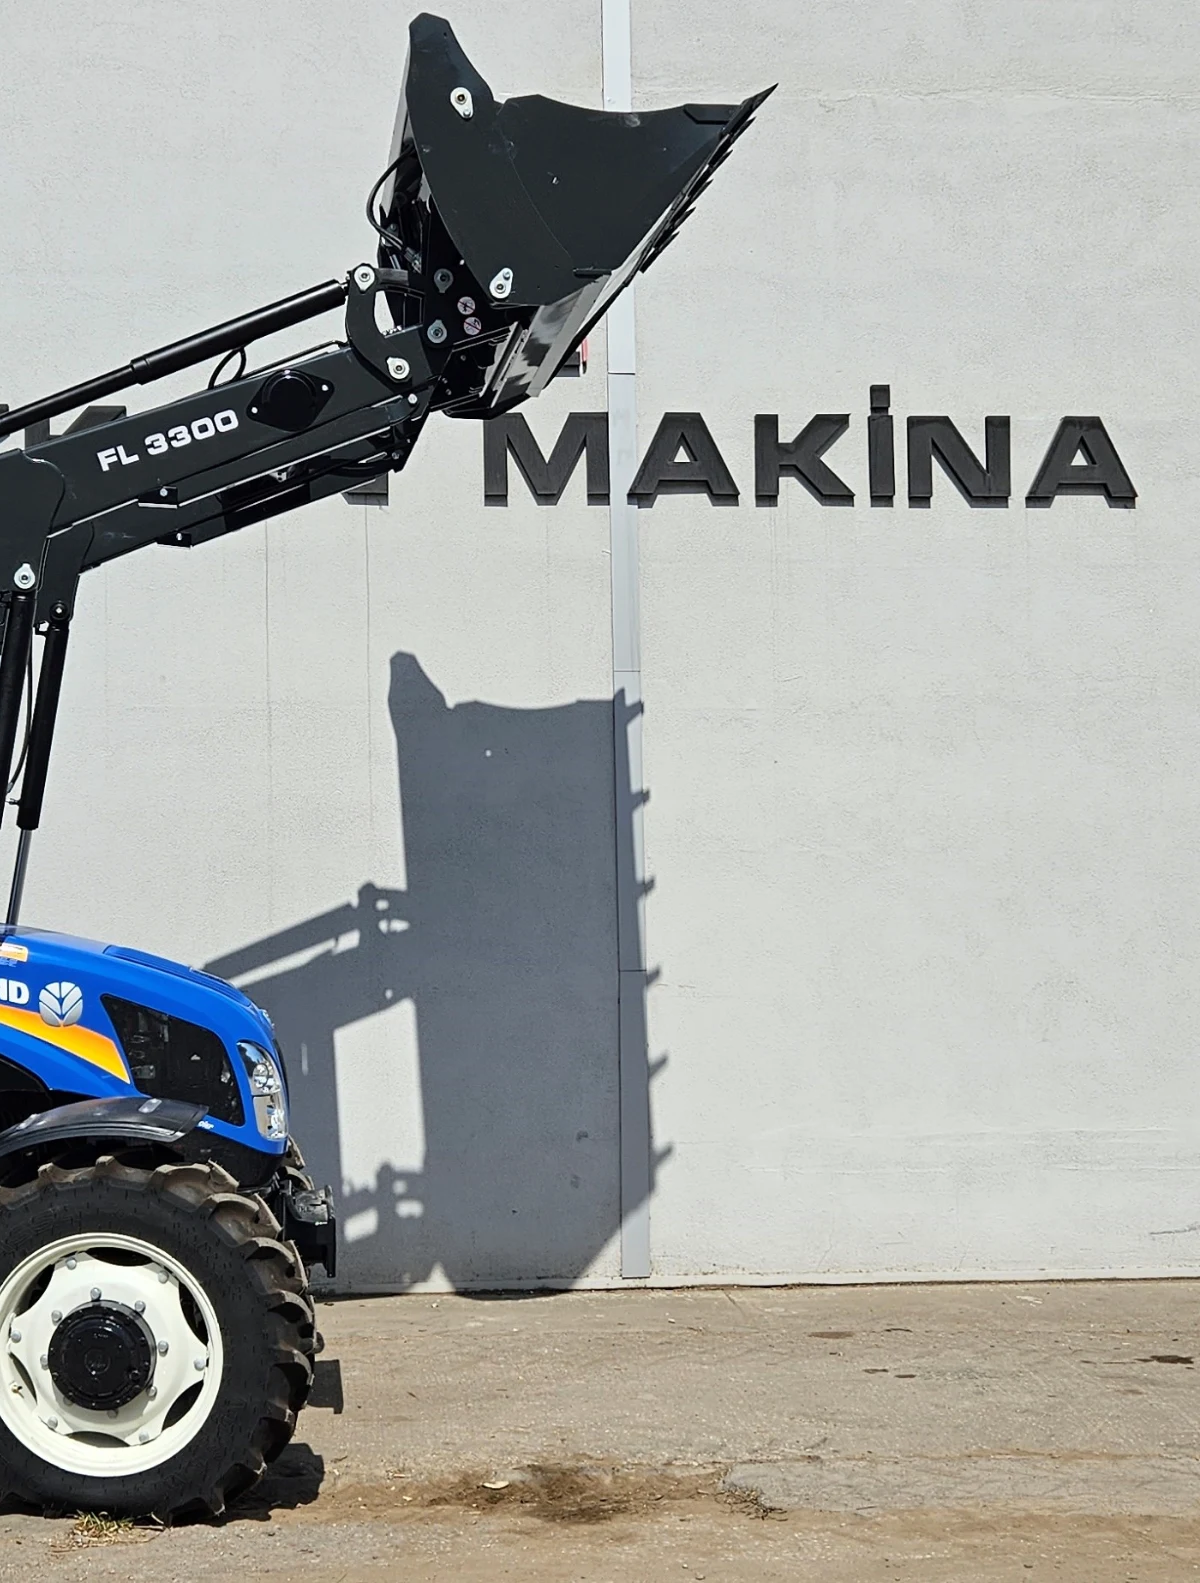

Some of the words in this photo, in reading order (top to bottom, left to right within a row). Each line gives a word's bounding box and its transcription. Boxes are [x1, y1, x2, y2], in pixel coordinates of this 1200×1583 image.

[96, 445, 140, 472] FL
[144, 409, 240, 456] 3300
[484, 385, 1136, 504] MAKİNA
